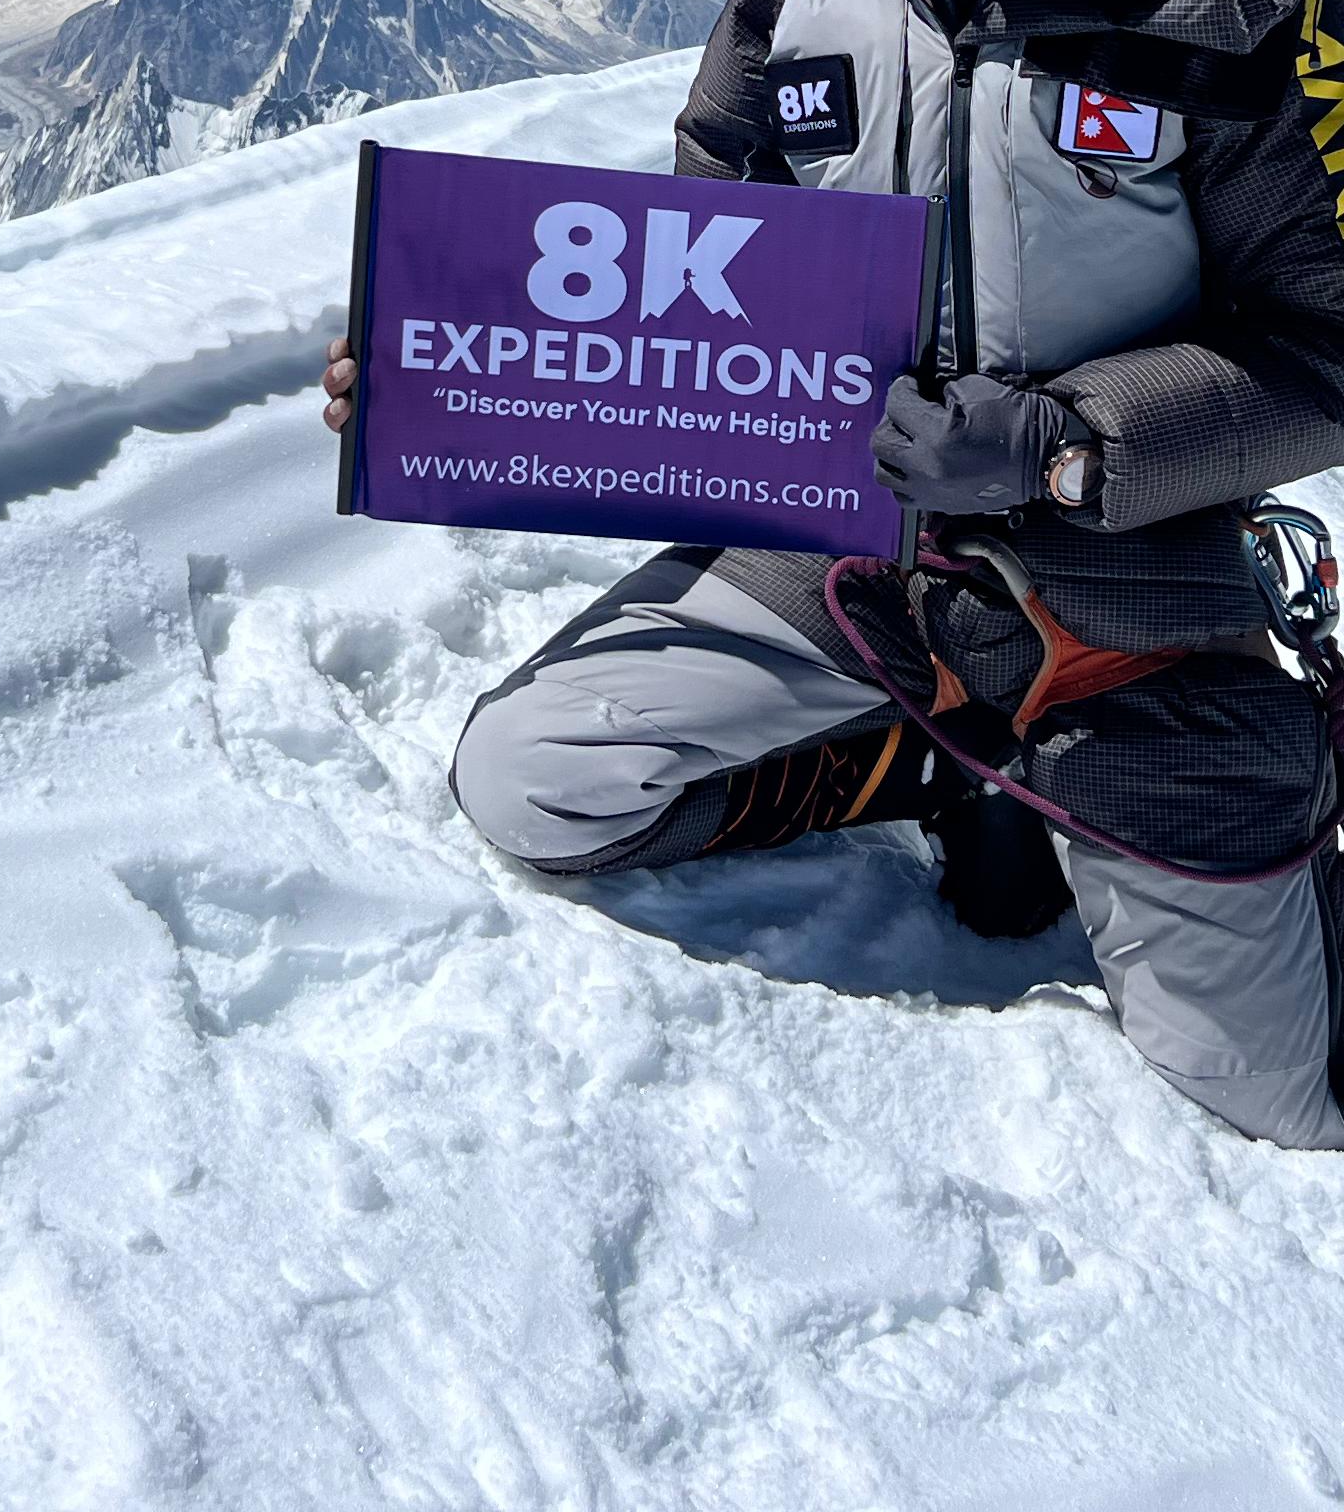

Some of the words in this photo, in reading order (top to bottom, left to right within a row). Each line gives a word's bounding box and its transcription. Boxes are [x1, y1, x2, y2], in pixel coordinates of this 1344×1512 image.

[778, 80, 831, 121] 8K
[784, 119, 837, 133] EXPEDITIONS
[526, 200, 765, 328] 8K
[399, 318, 874, 406] EXPEDITIONS
[582, 398, 651, 427] Your
[656, 404, 723, 433] New
[399, 453, 861, 512] www.8kexpeditions.com
